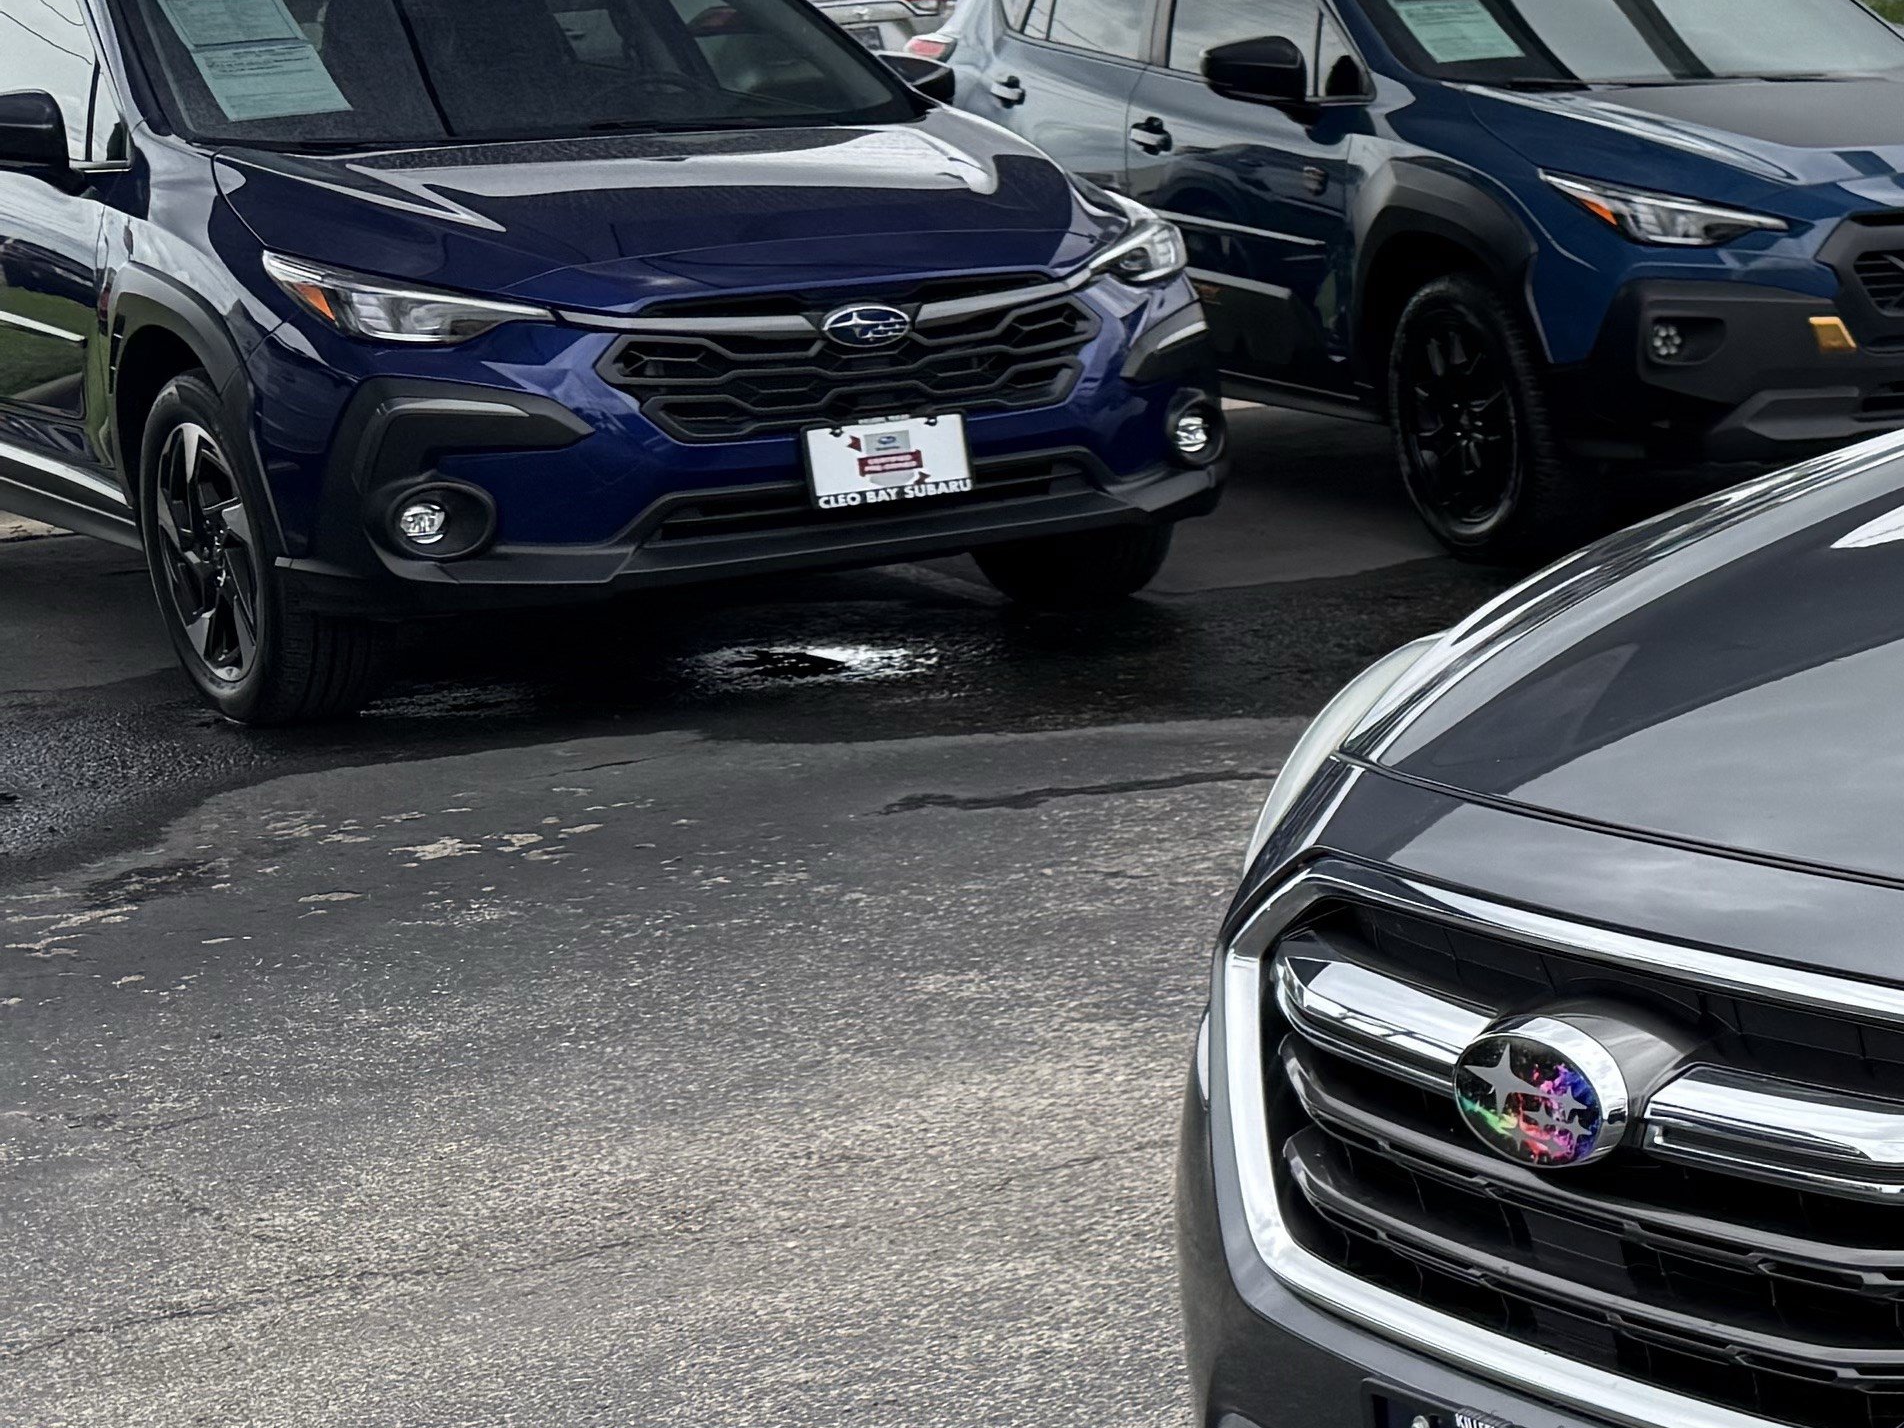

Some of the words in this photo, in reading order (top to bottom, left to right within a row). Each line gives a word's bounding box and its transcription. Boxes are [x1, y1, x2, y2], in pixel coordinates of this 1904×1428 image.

[818, 493, 861, 509] CLEO
[866, 488, 898, 504] BAY
[904, 479, 973, 499] SUBARU
